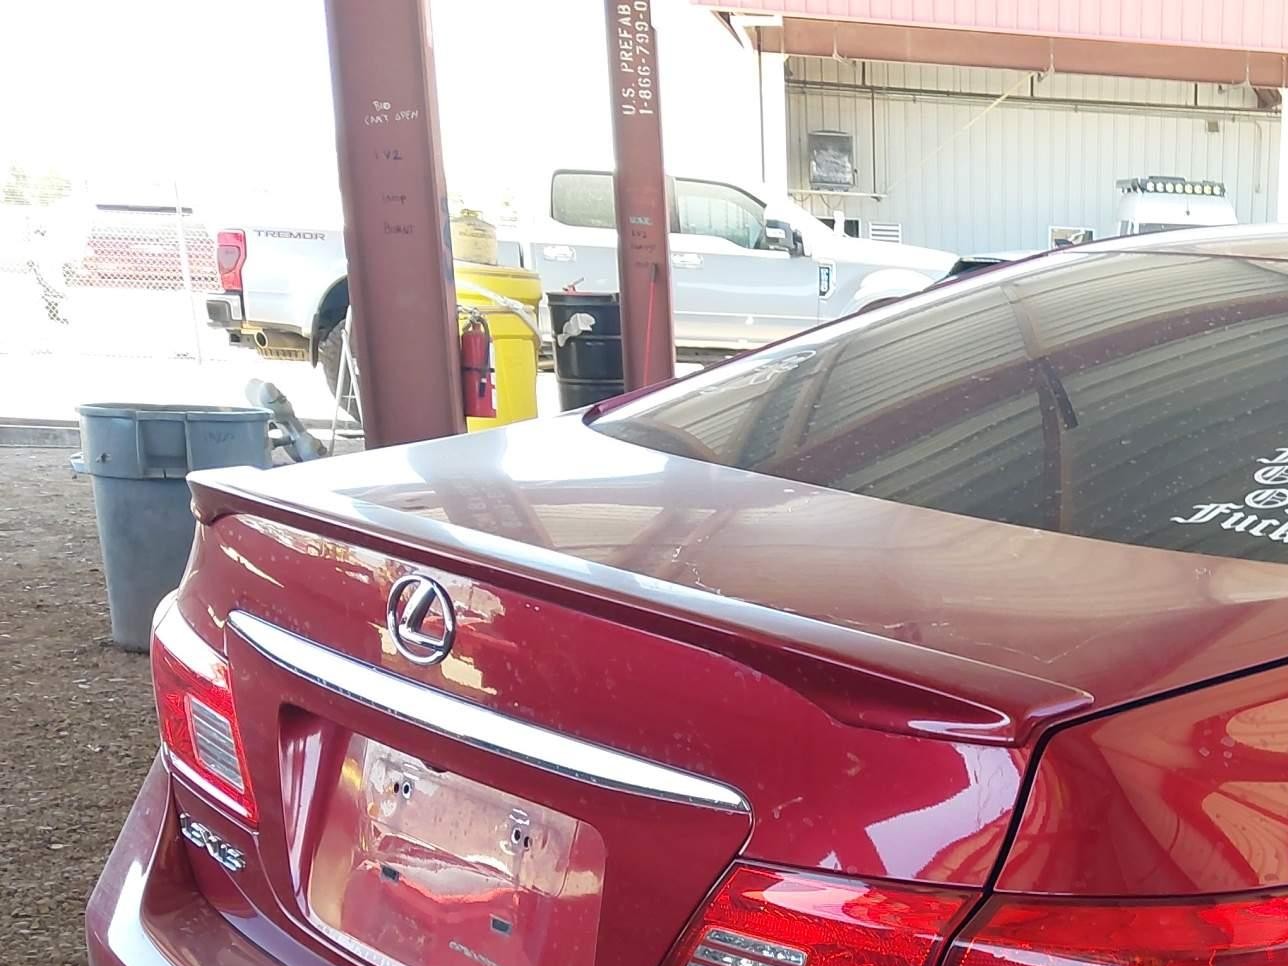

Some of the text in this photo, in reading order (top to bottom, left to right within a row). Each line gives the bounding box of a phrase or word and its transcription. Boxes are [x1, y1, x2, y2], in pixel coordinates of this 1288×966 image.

[617, 4, 636, 115] U.S. PREFAB
[253, 229, 326, 240] TREMOR
